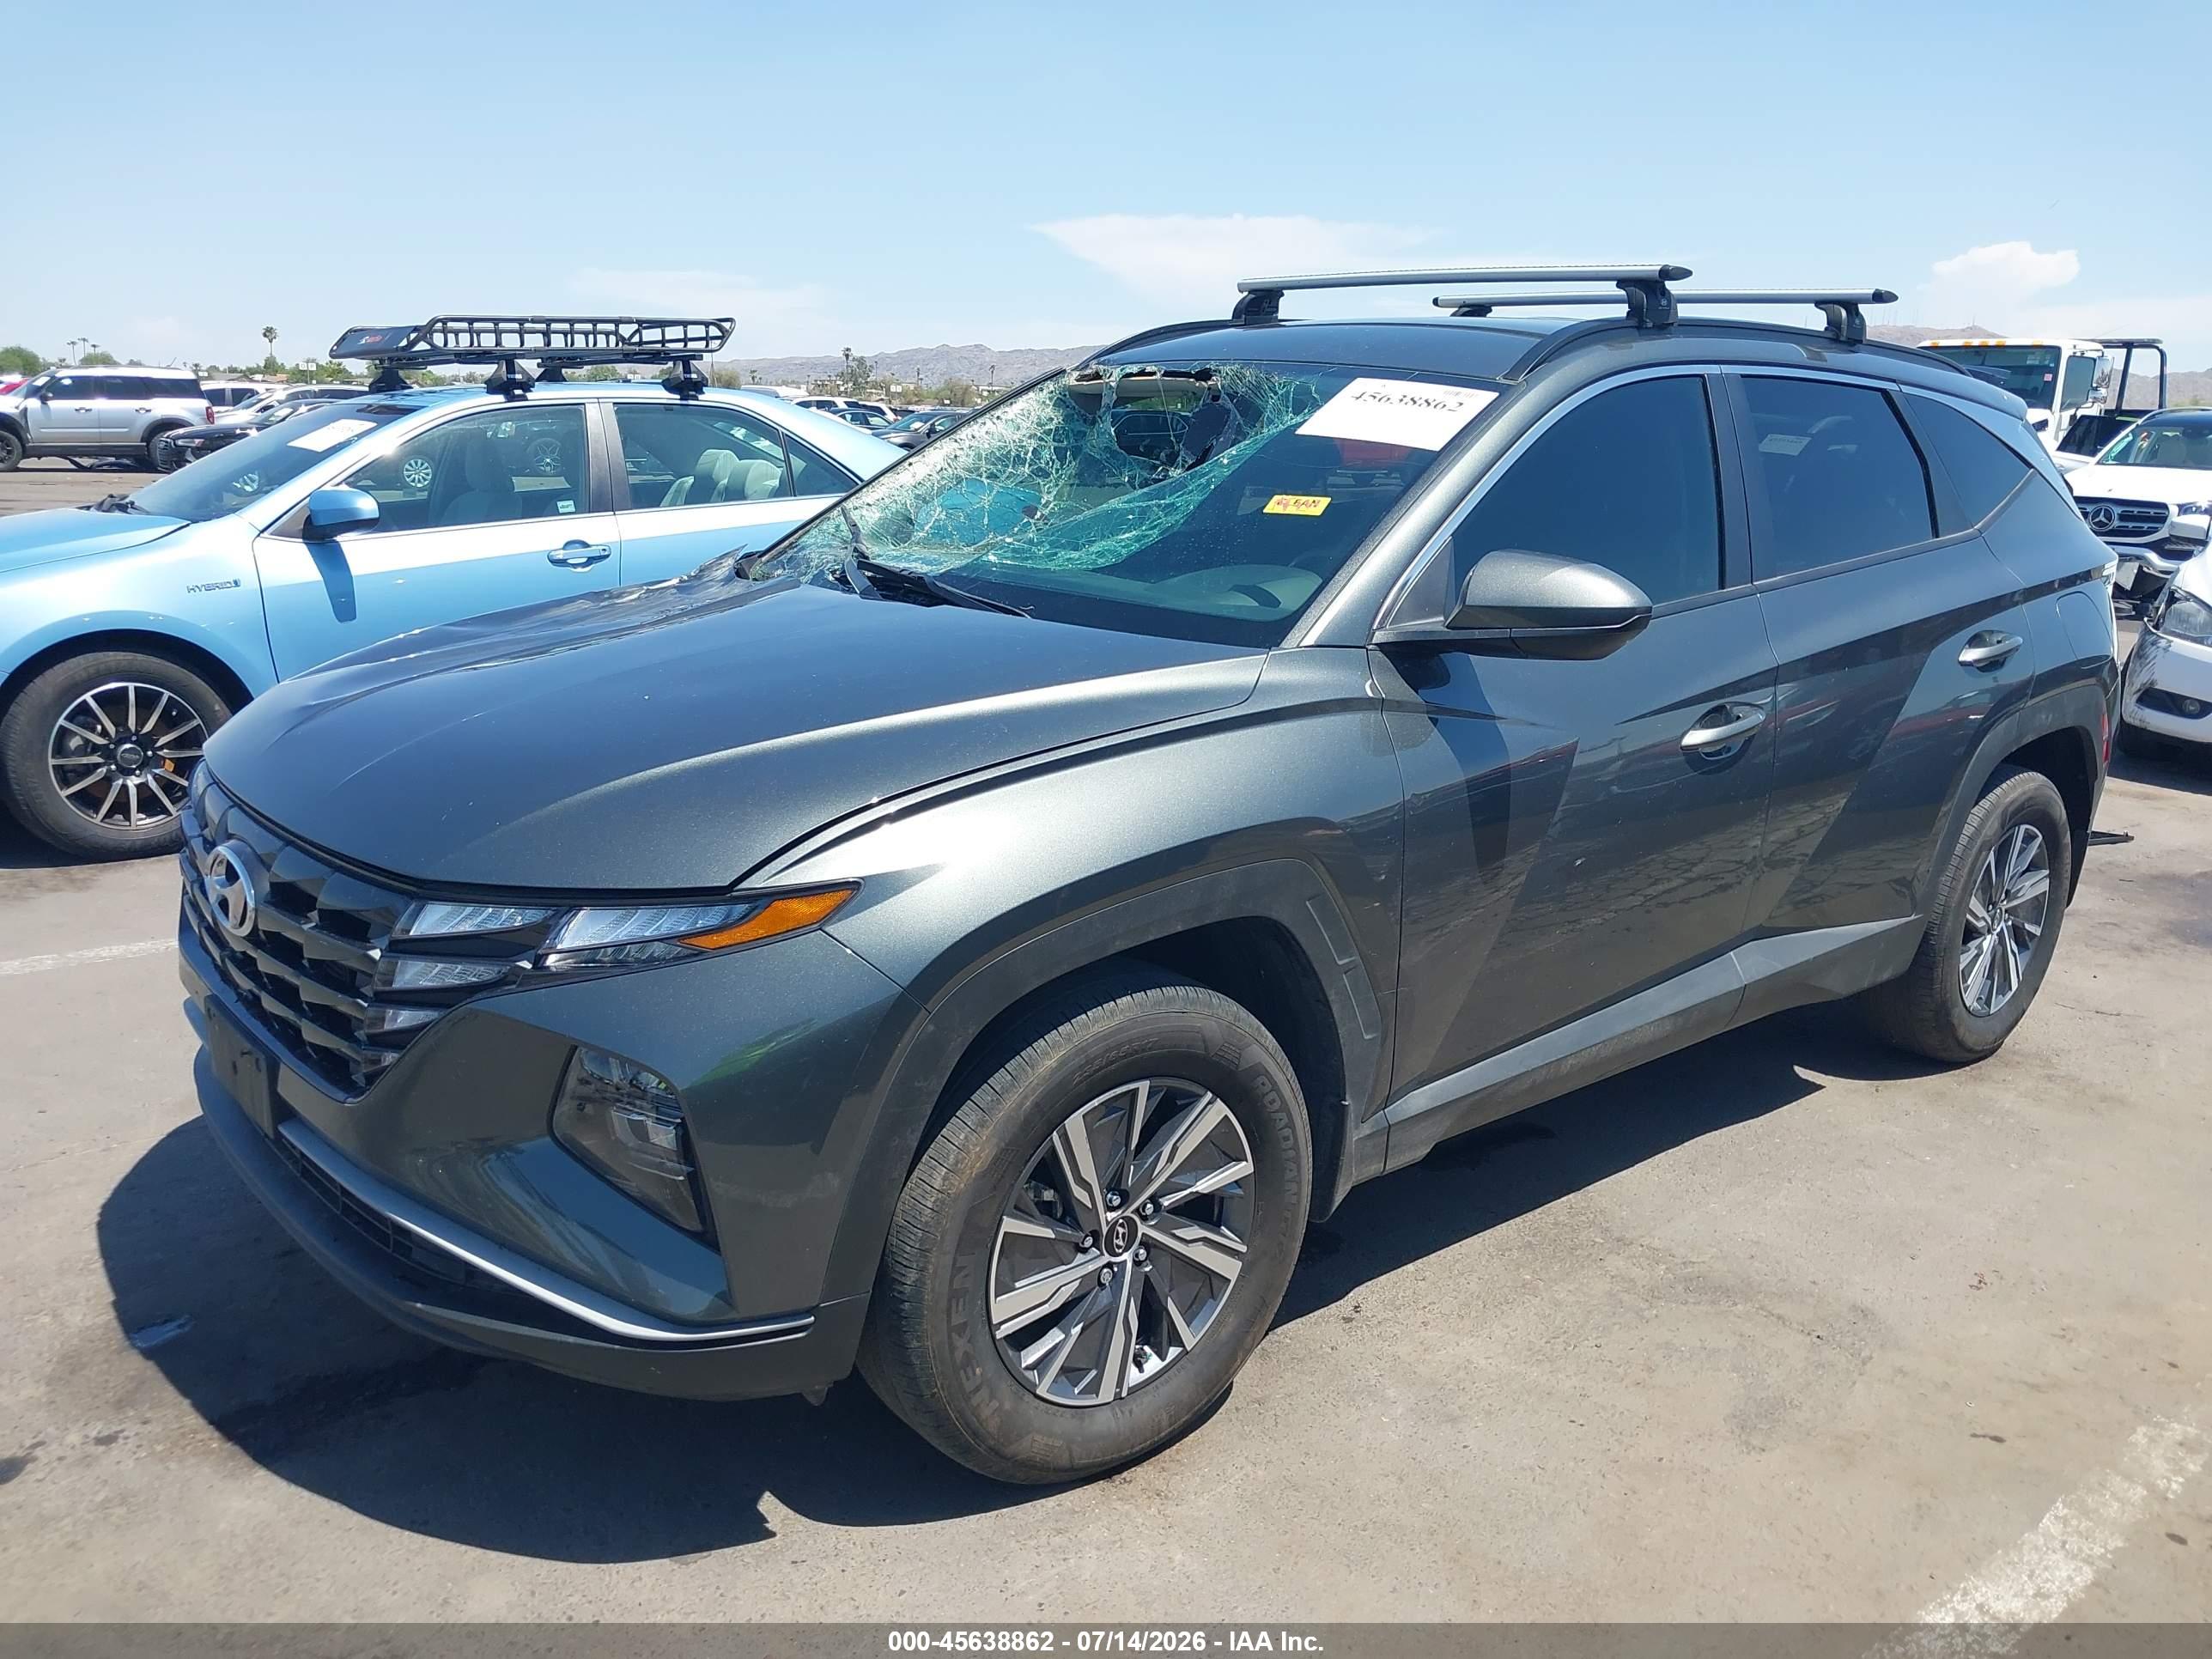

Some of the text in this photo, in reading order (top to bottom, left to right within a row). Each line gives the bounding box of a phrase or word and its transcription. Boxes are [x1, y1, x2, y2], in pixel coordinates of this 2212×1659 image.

[1350, 390, 1464, 413] 45638862
[186, 580, 232, 593] HYBRID
[951, 1252, 1000, 1417] NEXEN
